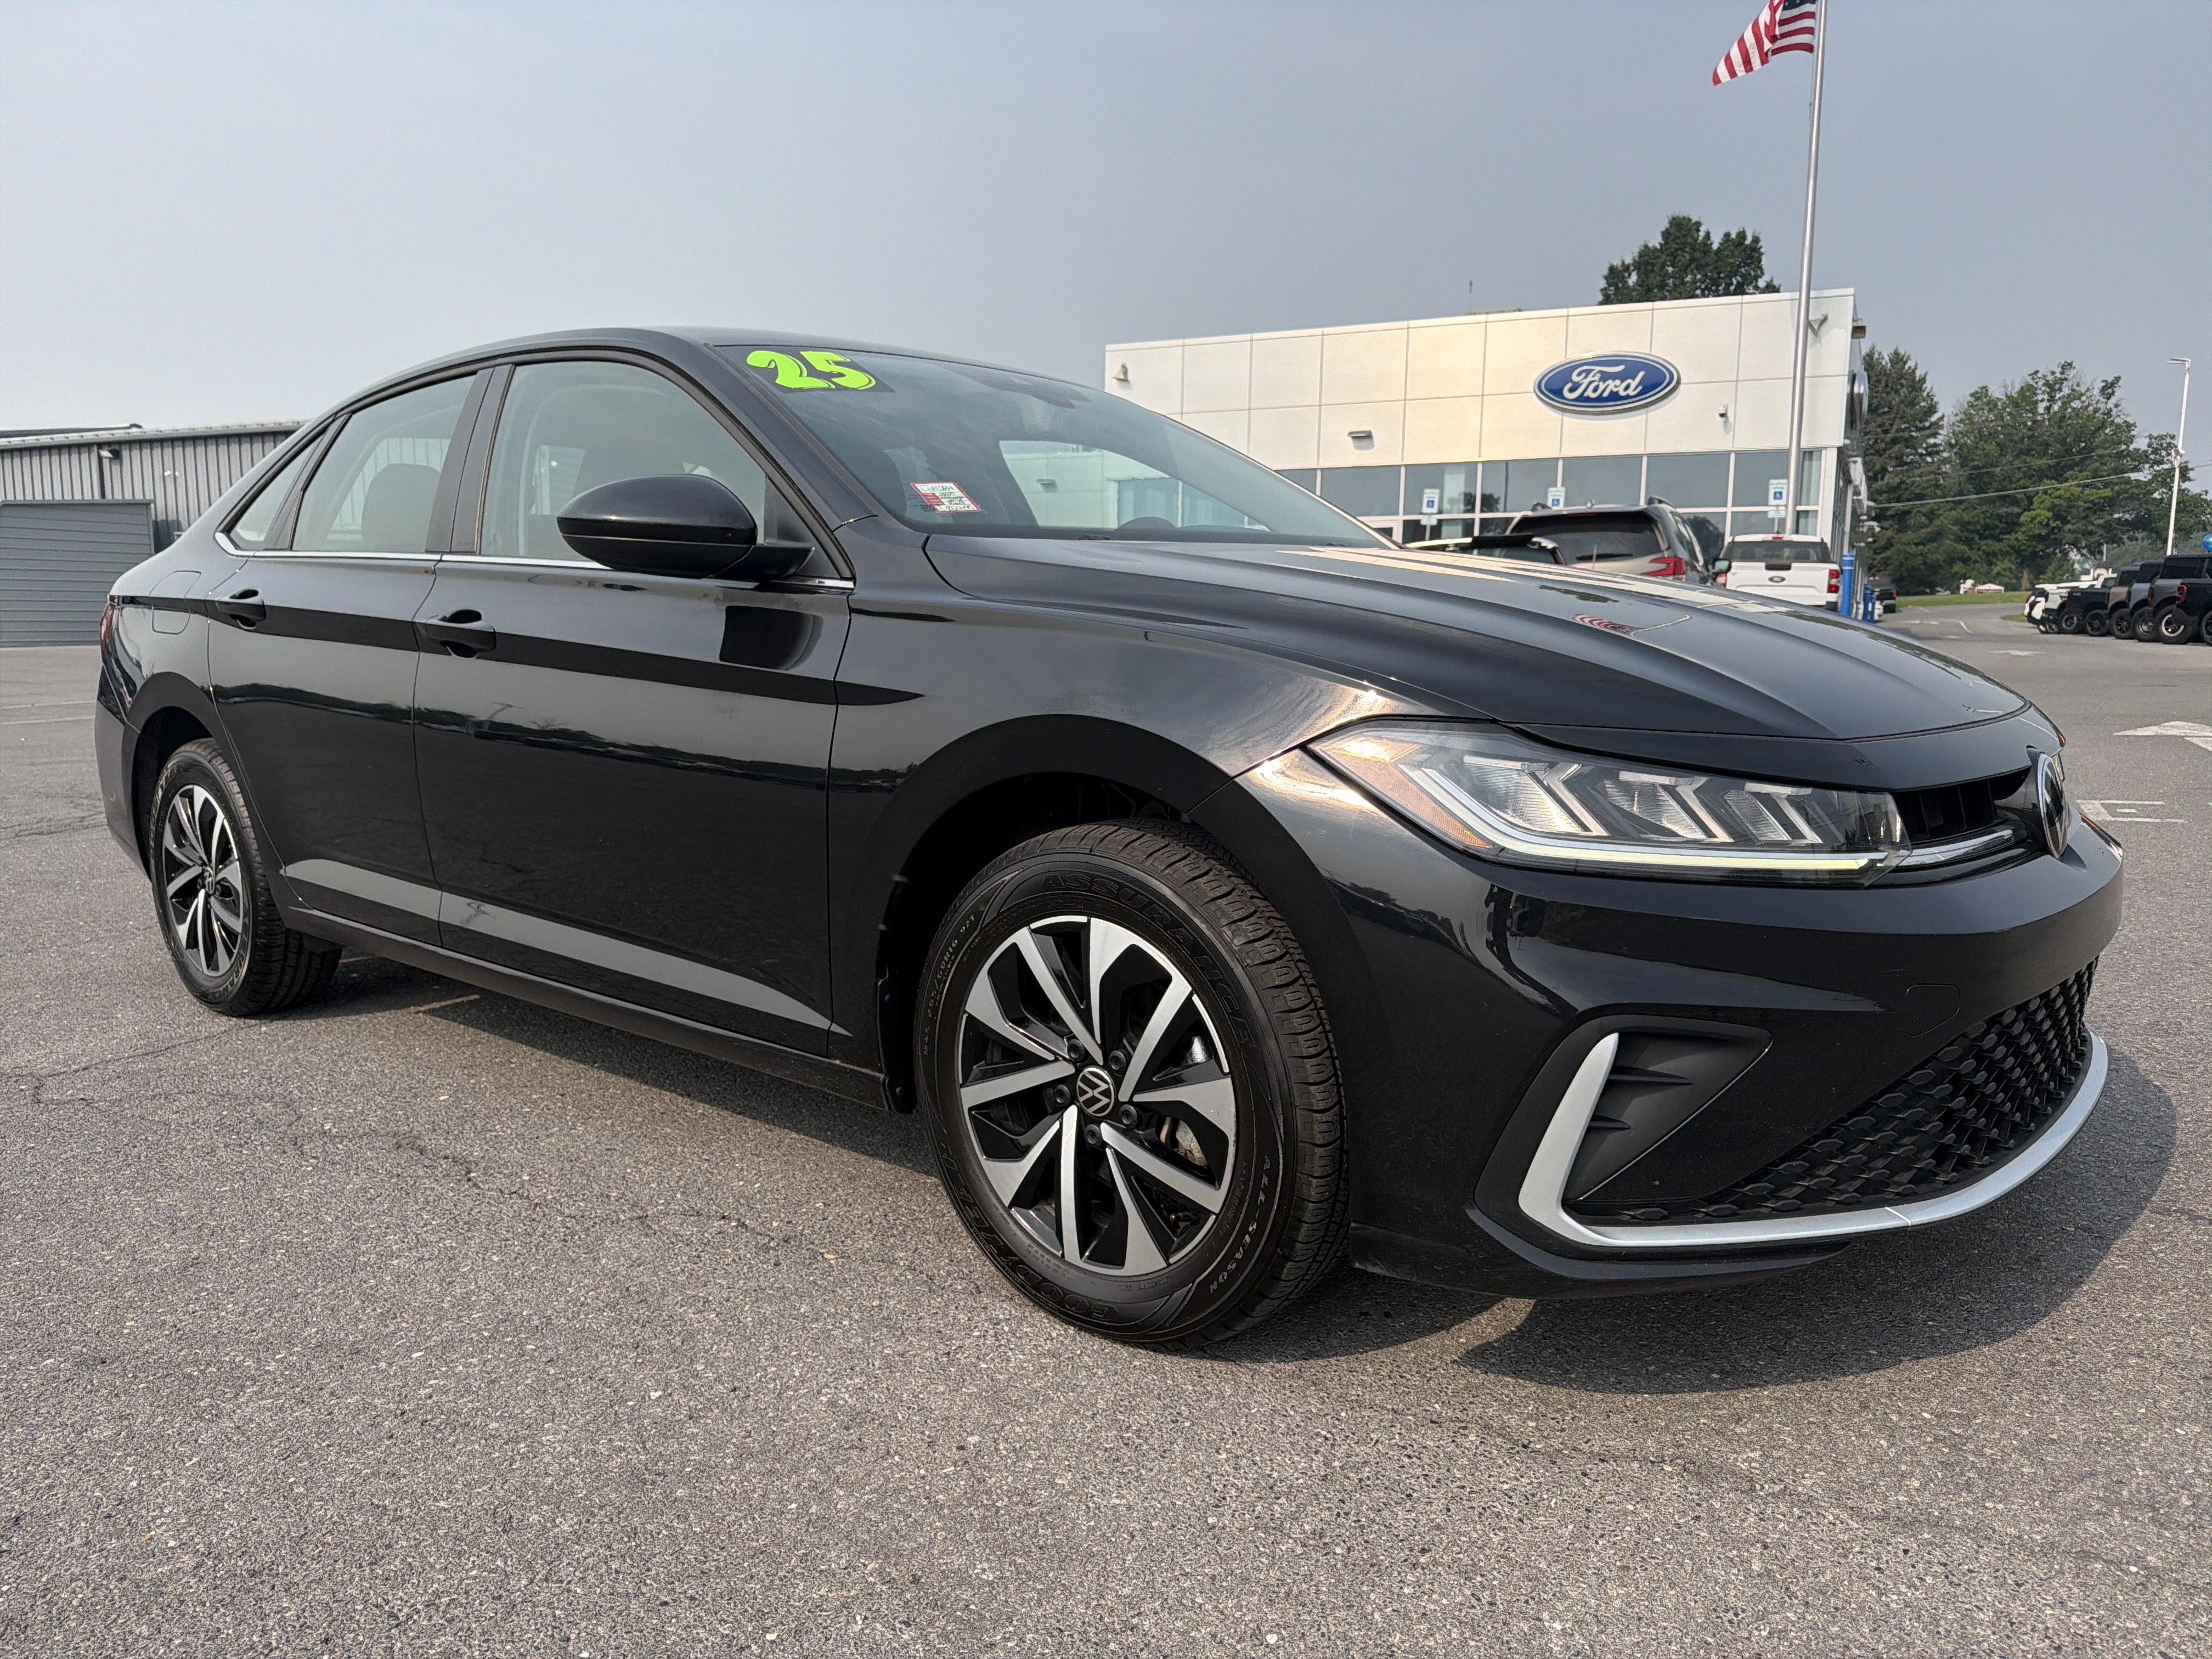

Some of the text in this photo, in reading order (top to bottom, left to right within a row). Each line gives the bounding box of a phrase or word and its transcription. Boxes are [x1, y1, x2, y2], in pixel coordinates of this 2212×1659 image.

[747, 351, 876, 390] 25
[1562, 364, 1646, 400] Ford
[959, 913, 977, 935] 92T
[1040, 873, 1256, 1049] ASSURANCE
[1208, 1154, 1272, 1295] ALL-SEASON
